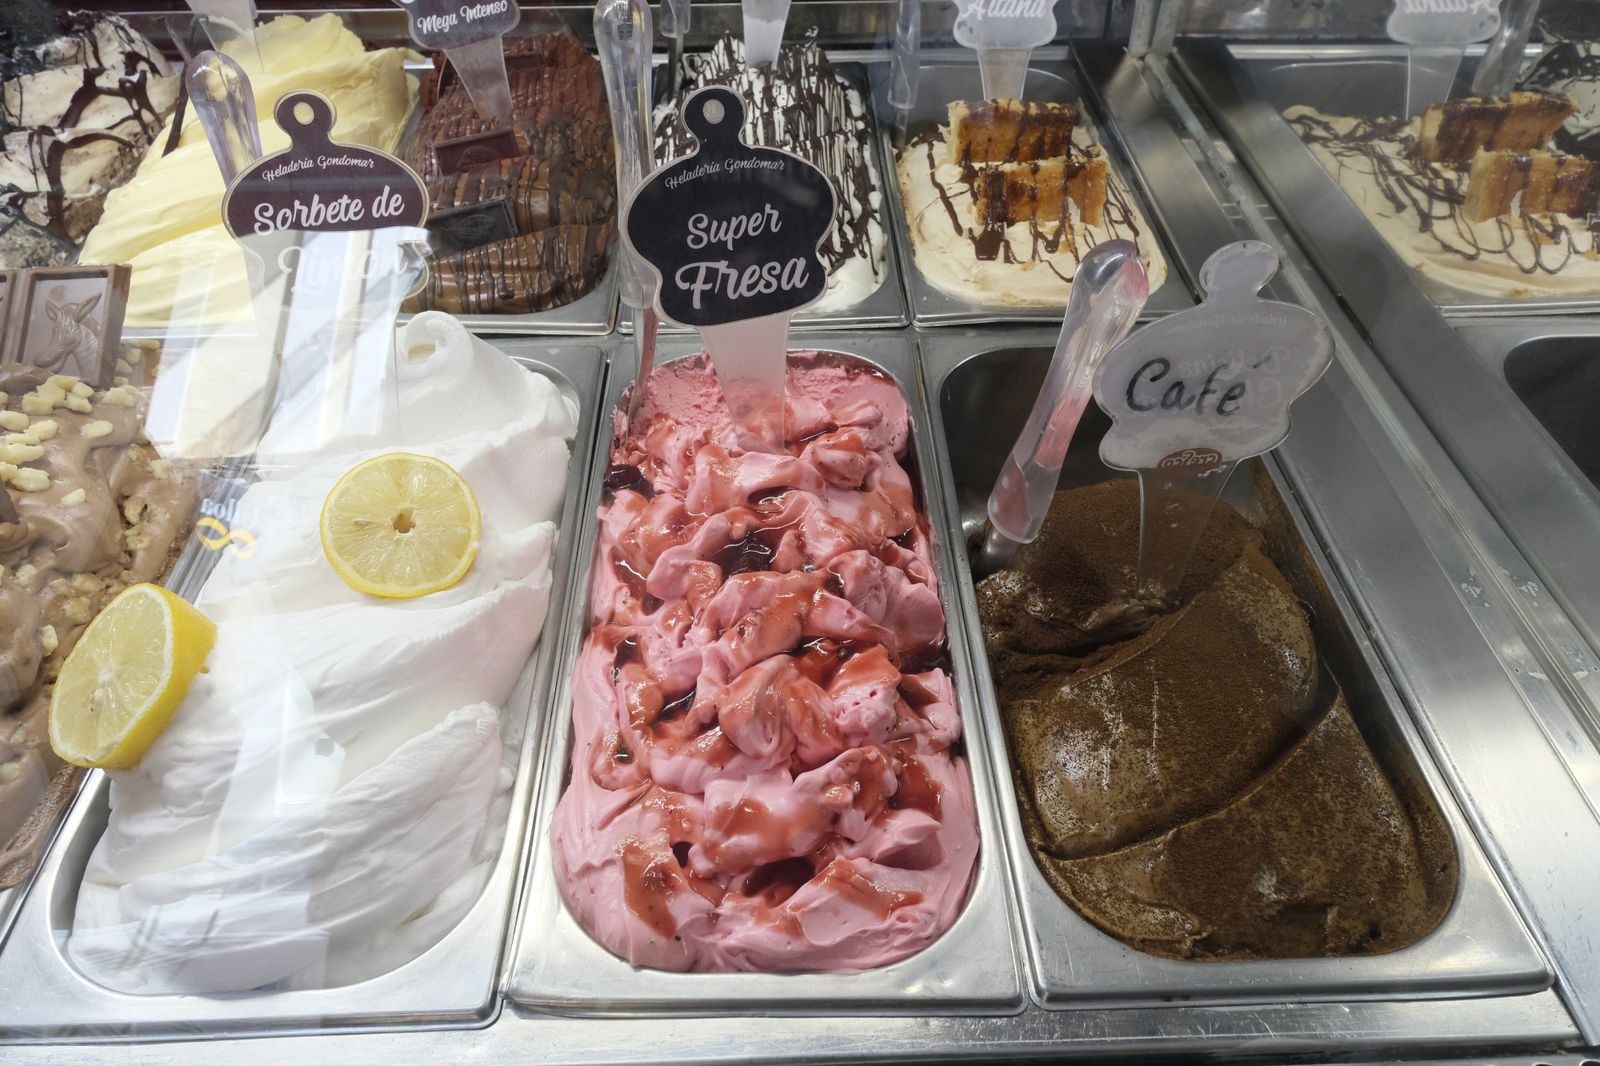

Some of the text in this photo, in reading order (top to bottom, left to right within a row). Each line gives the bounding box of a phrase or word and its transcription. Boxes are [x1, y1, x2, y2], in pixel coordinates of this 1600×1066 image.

[417, 0, 508, 35] Mega Intenso
[317, 155, 375, 169] Gondomar
[724, 156, 785, 174] Gondomar
[253, 184, 405, 236] Sorbete de
[686, 202, 782, 251] Super
[675, 256, 810, 310] Fresa
[1126, 354, 1272, 417] Café
